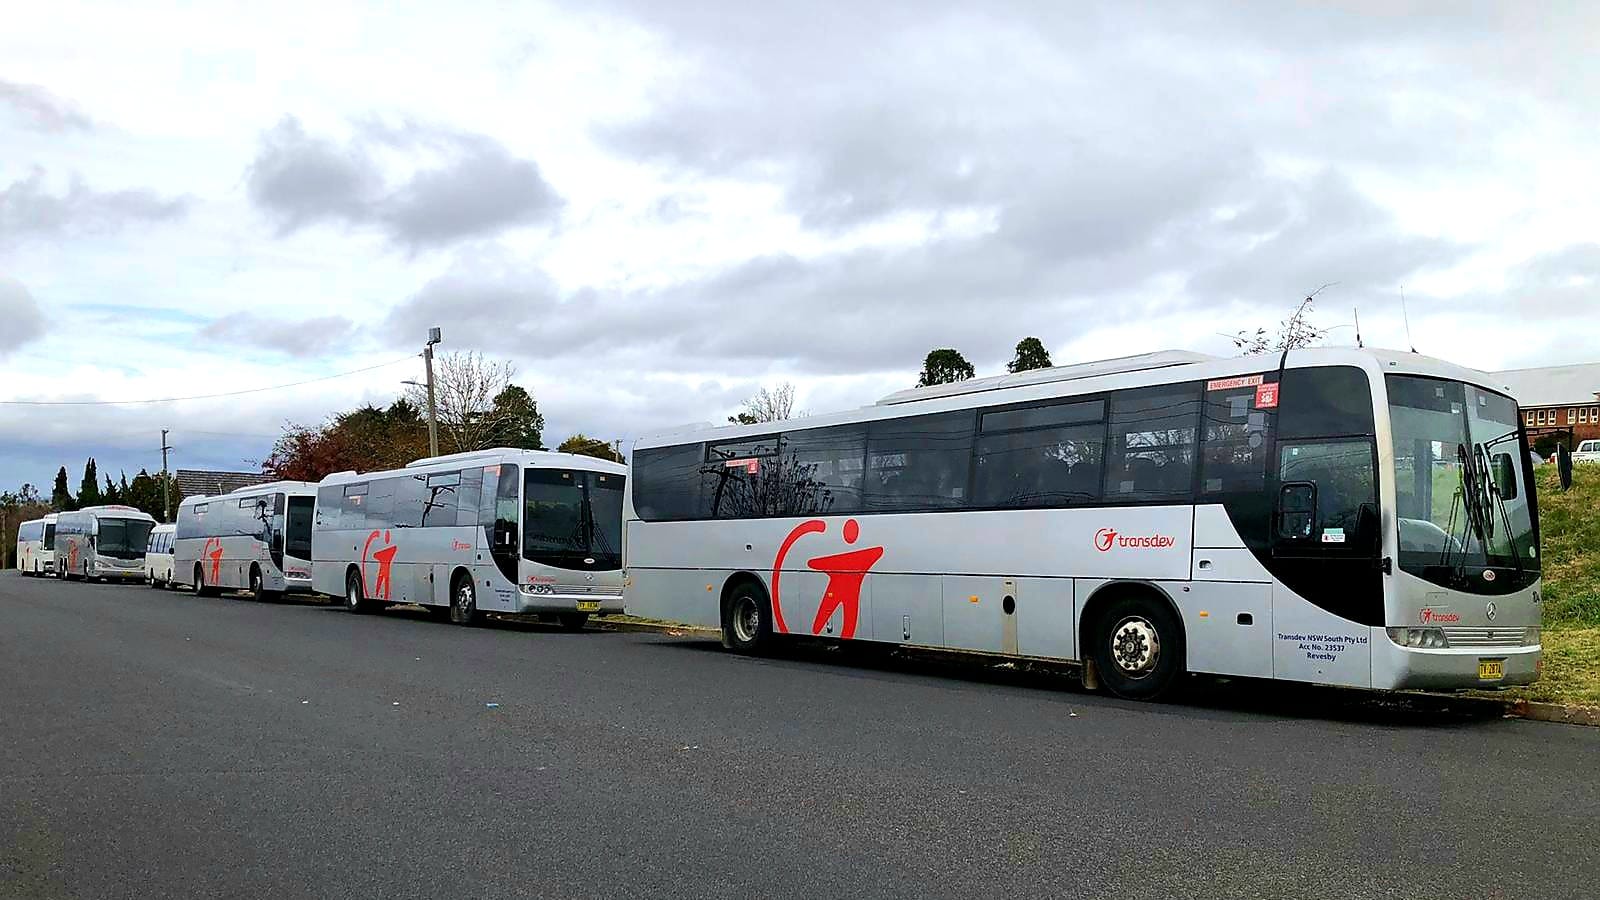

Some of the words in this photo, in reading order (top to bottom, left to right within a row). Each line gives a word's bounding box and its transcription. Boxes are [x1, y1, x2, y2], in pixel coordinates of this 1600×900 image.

[1209, 379, 1245, 390] EMERGENCY
[1247, 377, 1261, 386] EXIT
[1118, 534, 1175, 547] transdev
[1277, 633, 1306, 641] Transdev
[1307, 634, 1324, 642] NSW
[1324, 635, 1344, 643] South
[1344, 636, 1355, 645] Pty
[1298, 643, 1310, 651] Acc
[1311, 643, 1323, 651] No.
[1324, 644, 1345, 652] 23537
[1306, 651, 1337, 662] Revesby
